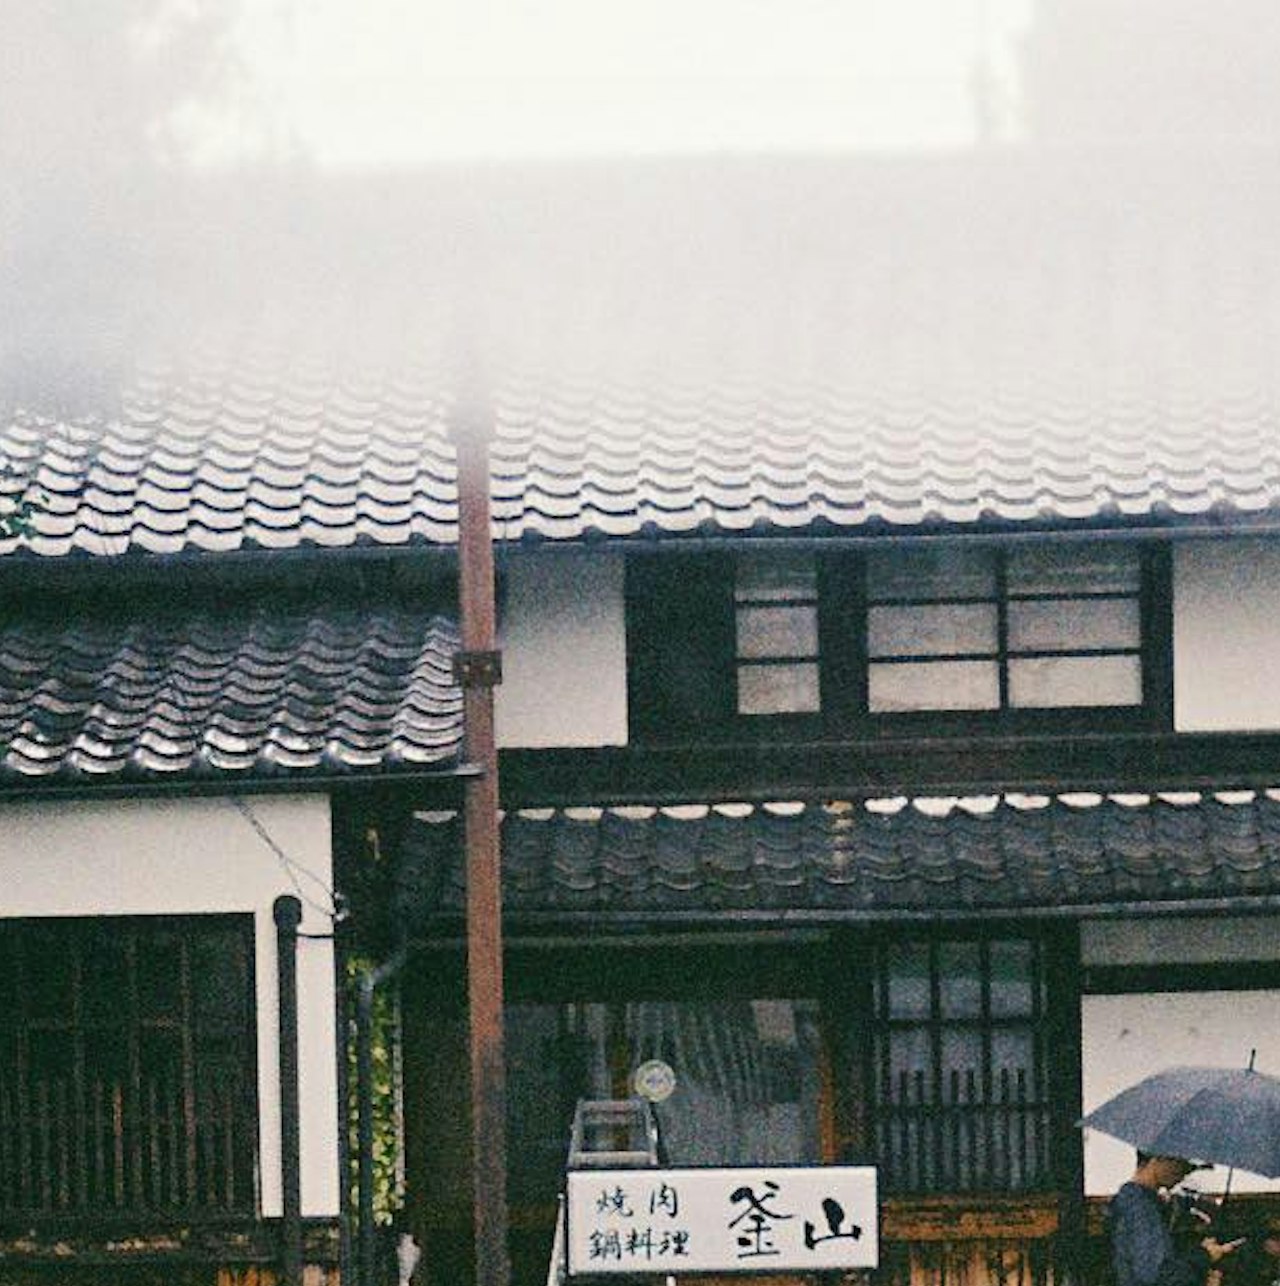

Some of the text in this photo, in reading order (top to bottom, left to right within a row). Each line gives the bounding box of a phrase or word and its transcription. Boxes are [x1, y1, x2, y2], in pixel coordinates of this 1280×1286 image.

[595, 1183, 679, 1219] 焼肉
[727, 1180, 863, 1259] 釜山
[588, 1226, 690, 1261] 鍋料理
